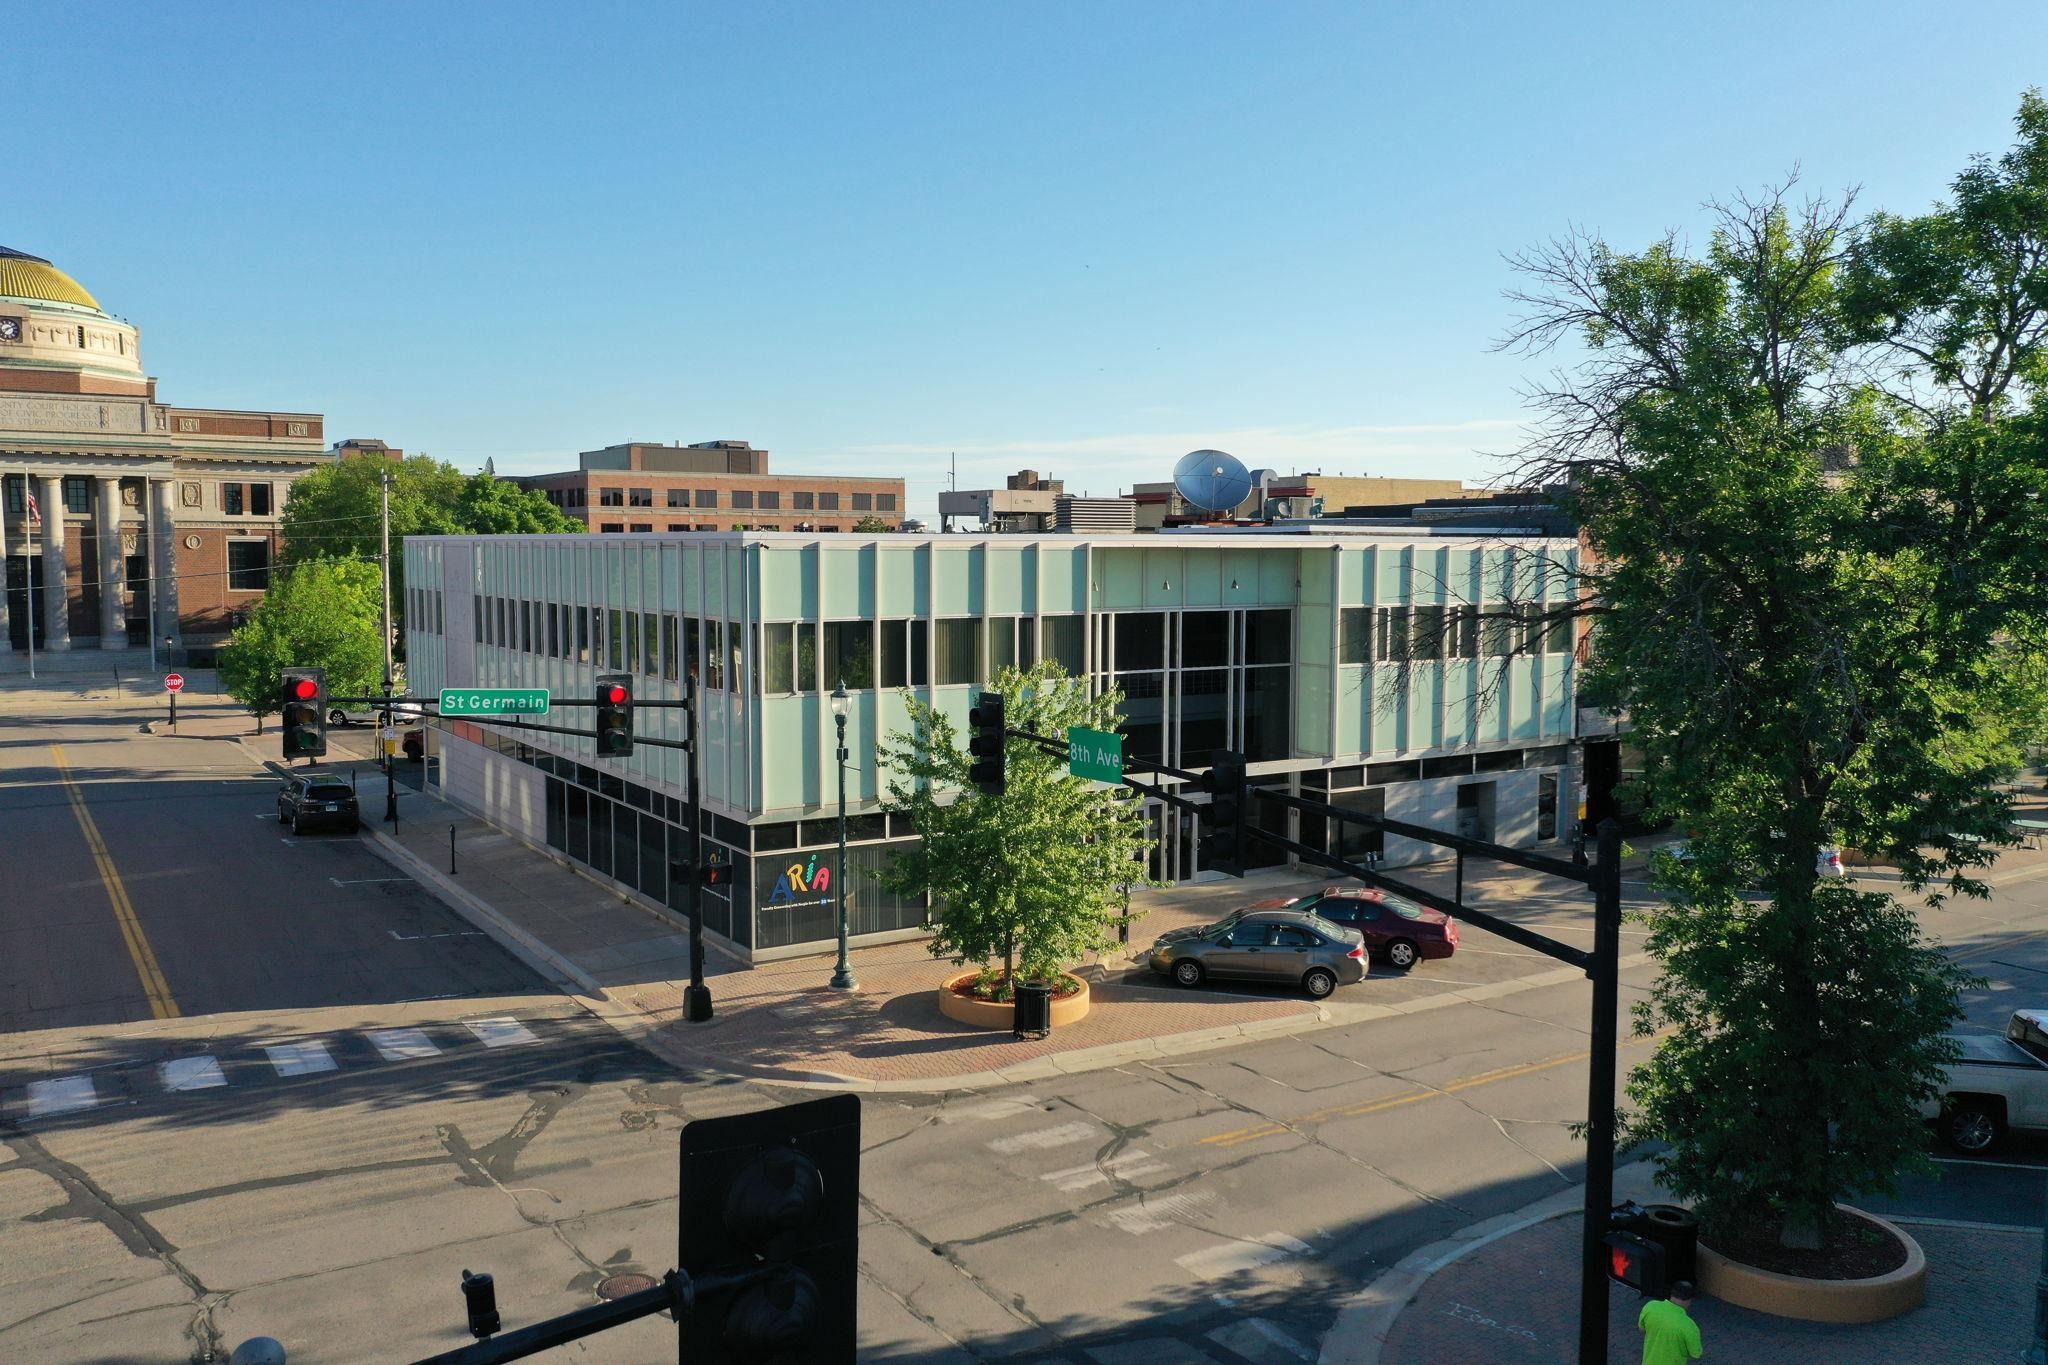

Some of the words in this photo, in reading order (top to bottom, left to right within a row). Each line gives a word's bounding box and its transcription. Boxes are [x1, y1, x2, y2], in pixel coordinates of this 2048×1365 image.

[26, 401, 58, 410] COURT
[445, 695, 464, 709] St
[469, 695, 544, 709] Germain
[1070, 742, 1090, 763] 8th
[1096, 747, 1120, 768] Ave
